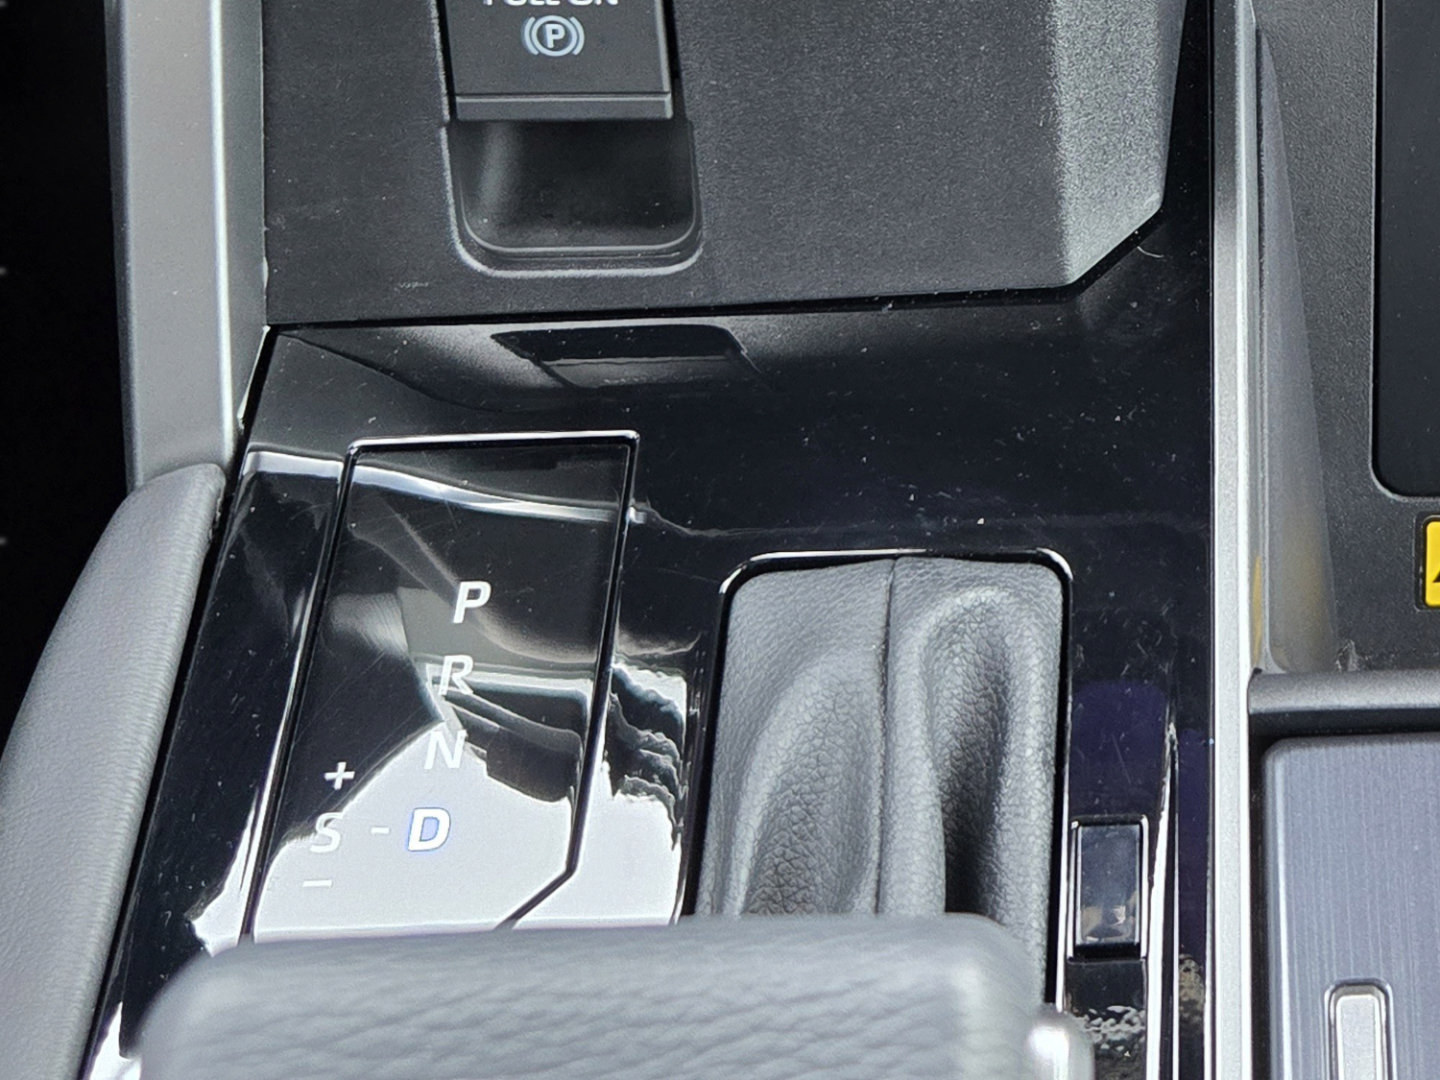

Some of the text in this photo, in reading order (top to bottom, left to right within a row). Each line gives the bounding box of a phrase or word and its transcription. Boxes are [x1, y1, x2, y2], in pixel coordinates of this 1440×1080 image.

[544, 23, 566, 49] P
[453, 581, 492, 624] P
[438, 654, 474, 696] R
[424, 729, 468, 771] N
[309, 812, 344, 853] S
[406, 806, 452, 852] D
